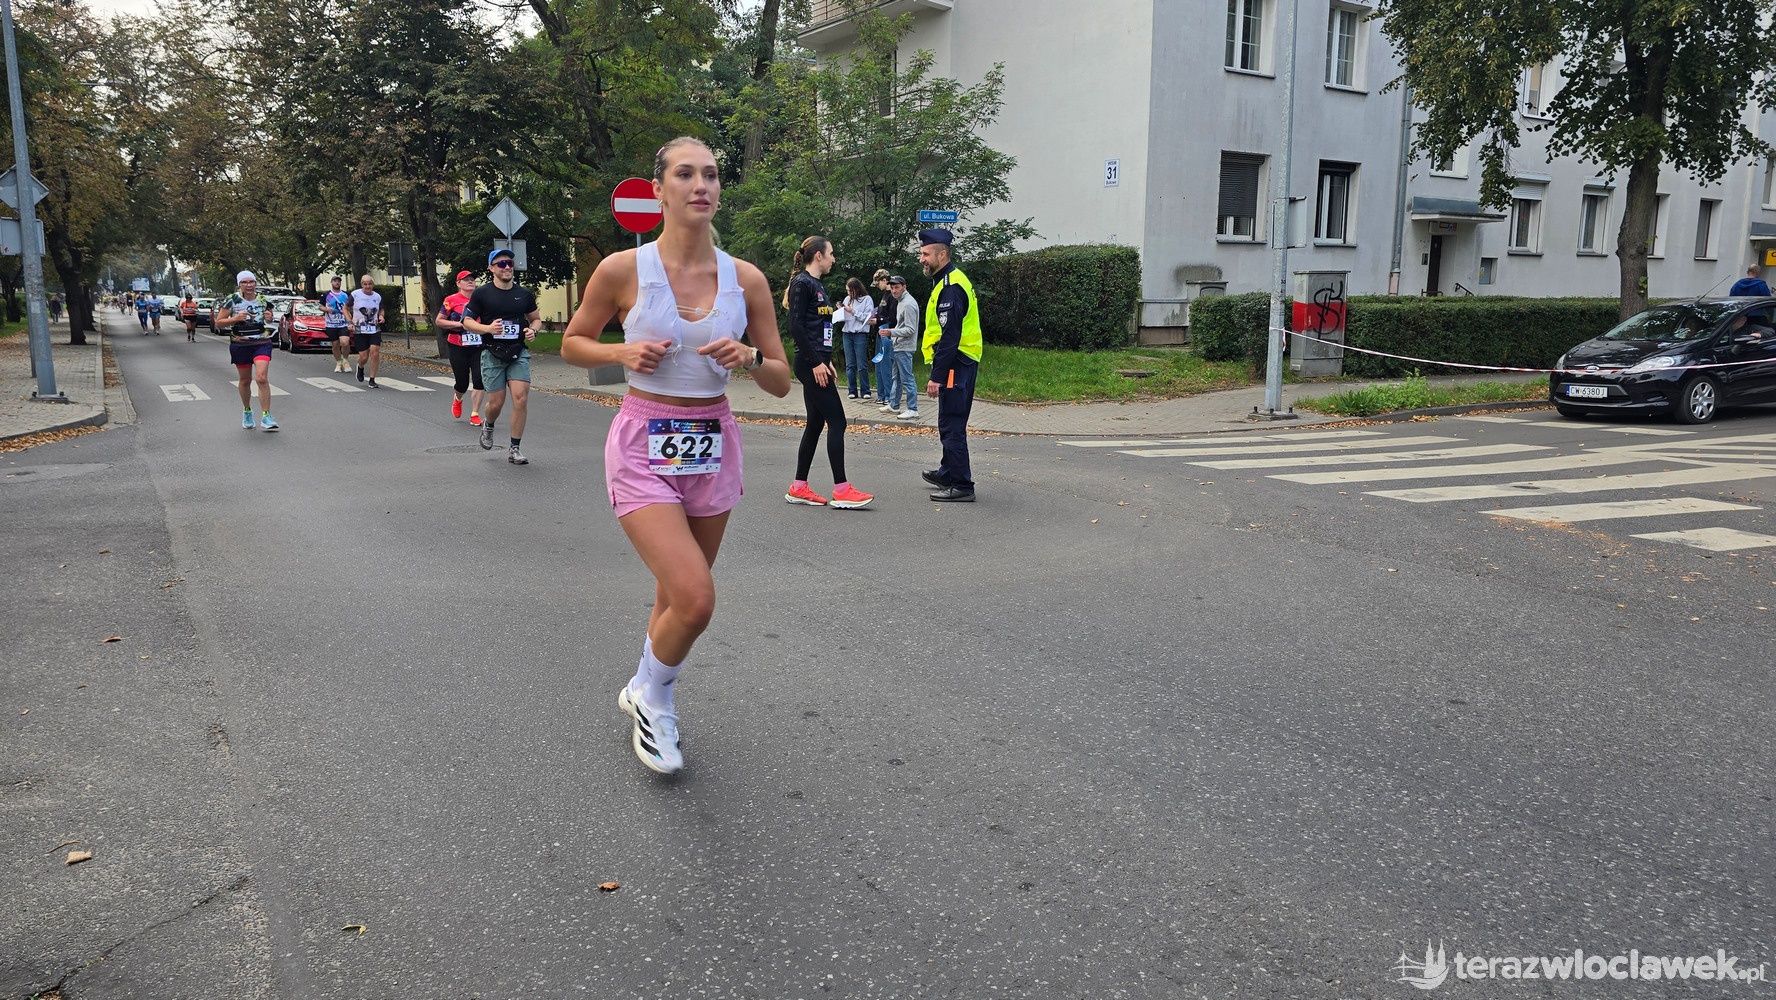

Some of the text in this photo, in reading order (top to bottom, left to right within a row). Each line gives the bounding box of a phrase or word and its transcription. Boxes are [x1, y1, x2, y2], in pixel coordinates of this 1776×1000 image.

[1106, 166, 1117, 180] 31
[504, 325, 517, 335] 55
[1571, 386, 1605, 396] CW 6380J
[660, 435, 714, 459] 622
